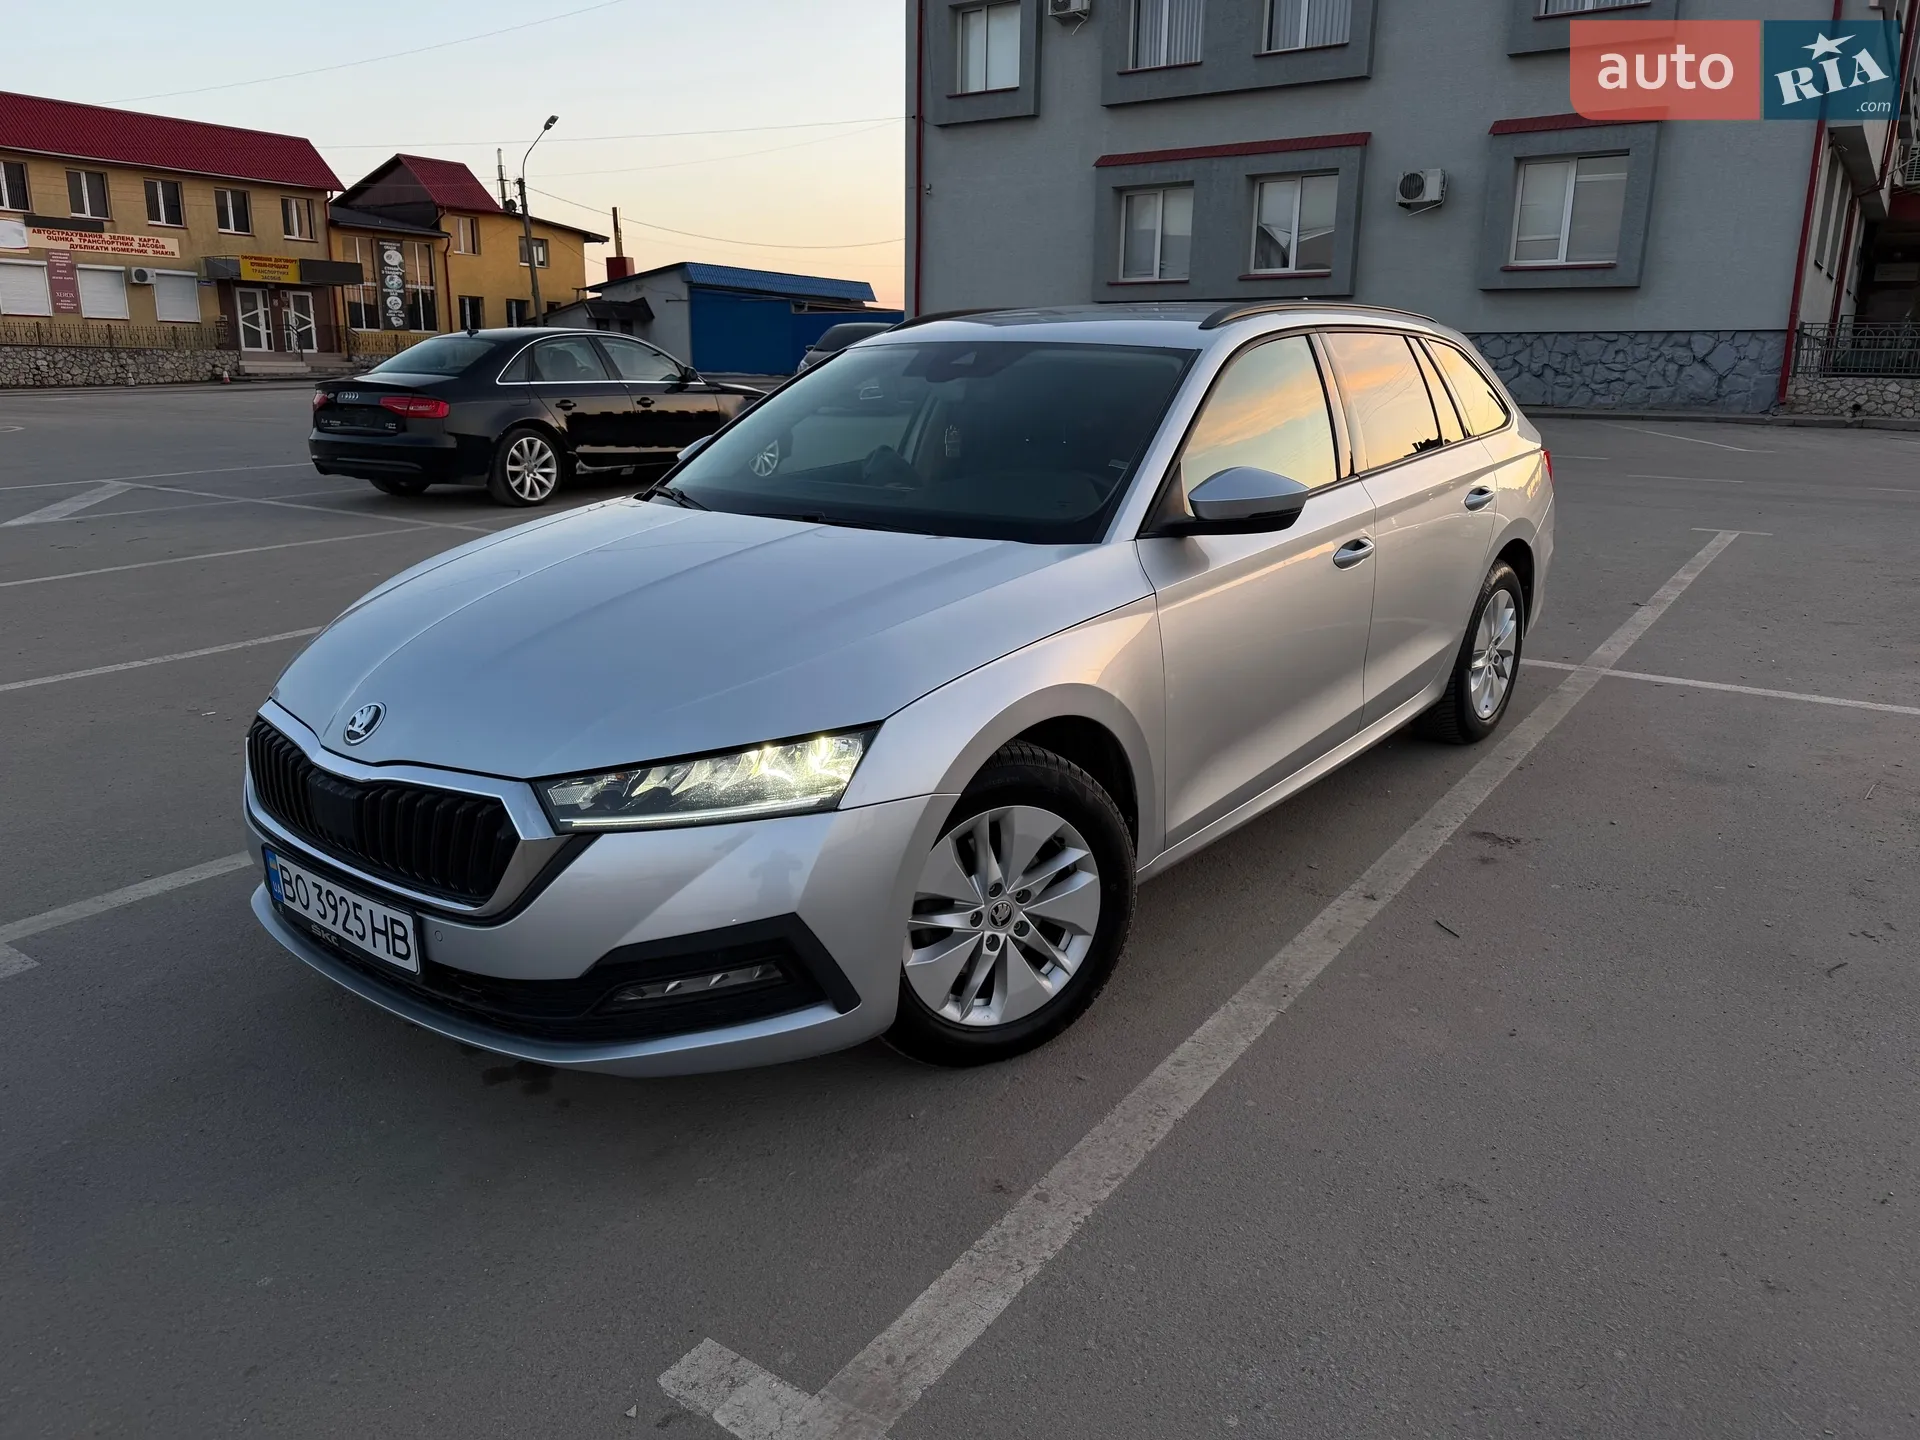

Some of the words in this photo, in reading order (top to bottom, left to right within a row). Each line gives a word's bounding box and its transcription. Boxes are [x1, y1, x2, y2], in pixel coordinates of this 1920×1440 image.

[47, 235, 74, 243] ОЦІНКА
[78, 238, 134, 247] ТРАНСПОРТНИХ
[137, 242, 166, 250] ЗАСОБІВ
[109, 234, 135, 242] ЗЕЛЕНА
[69, 244, 109, 252] ДУБЛІКАТИ
[111, 245, 148, 254] НОМЕРНИХ
[273, 880, 282, 894] UA
[280, 864, 310, 911] BO
[312, 881, 367, 942] 3925
[369, 909, 411, 961] HB
